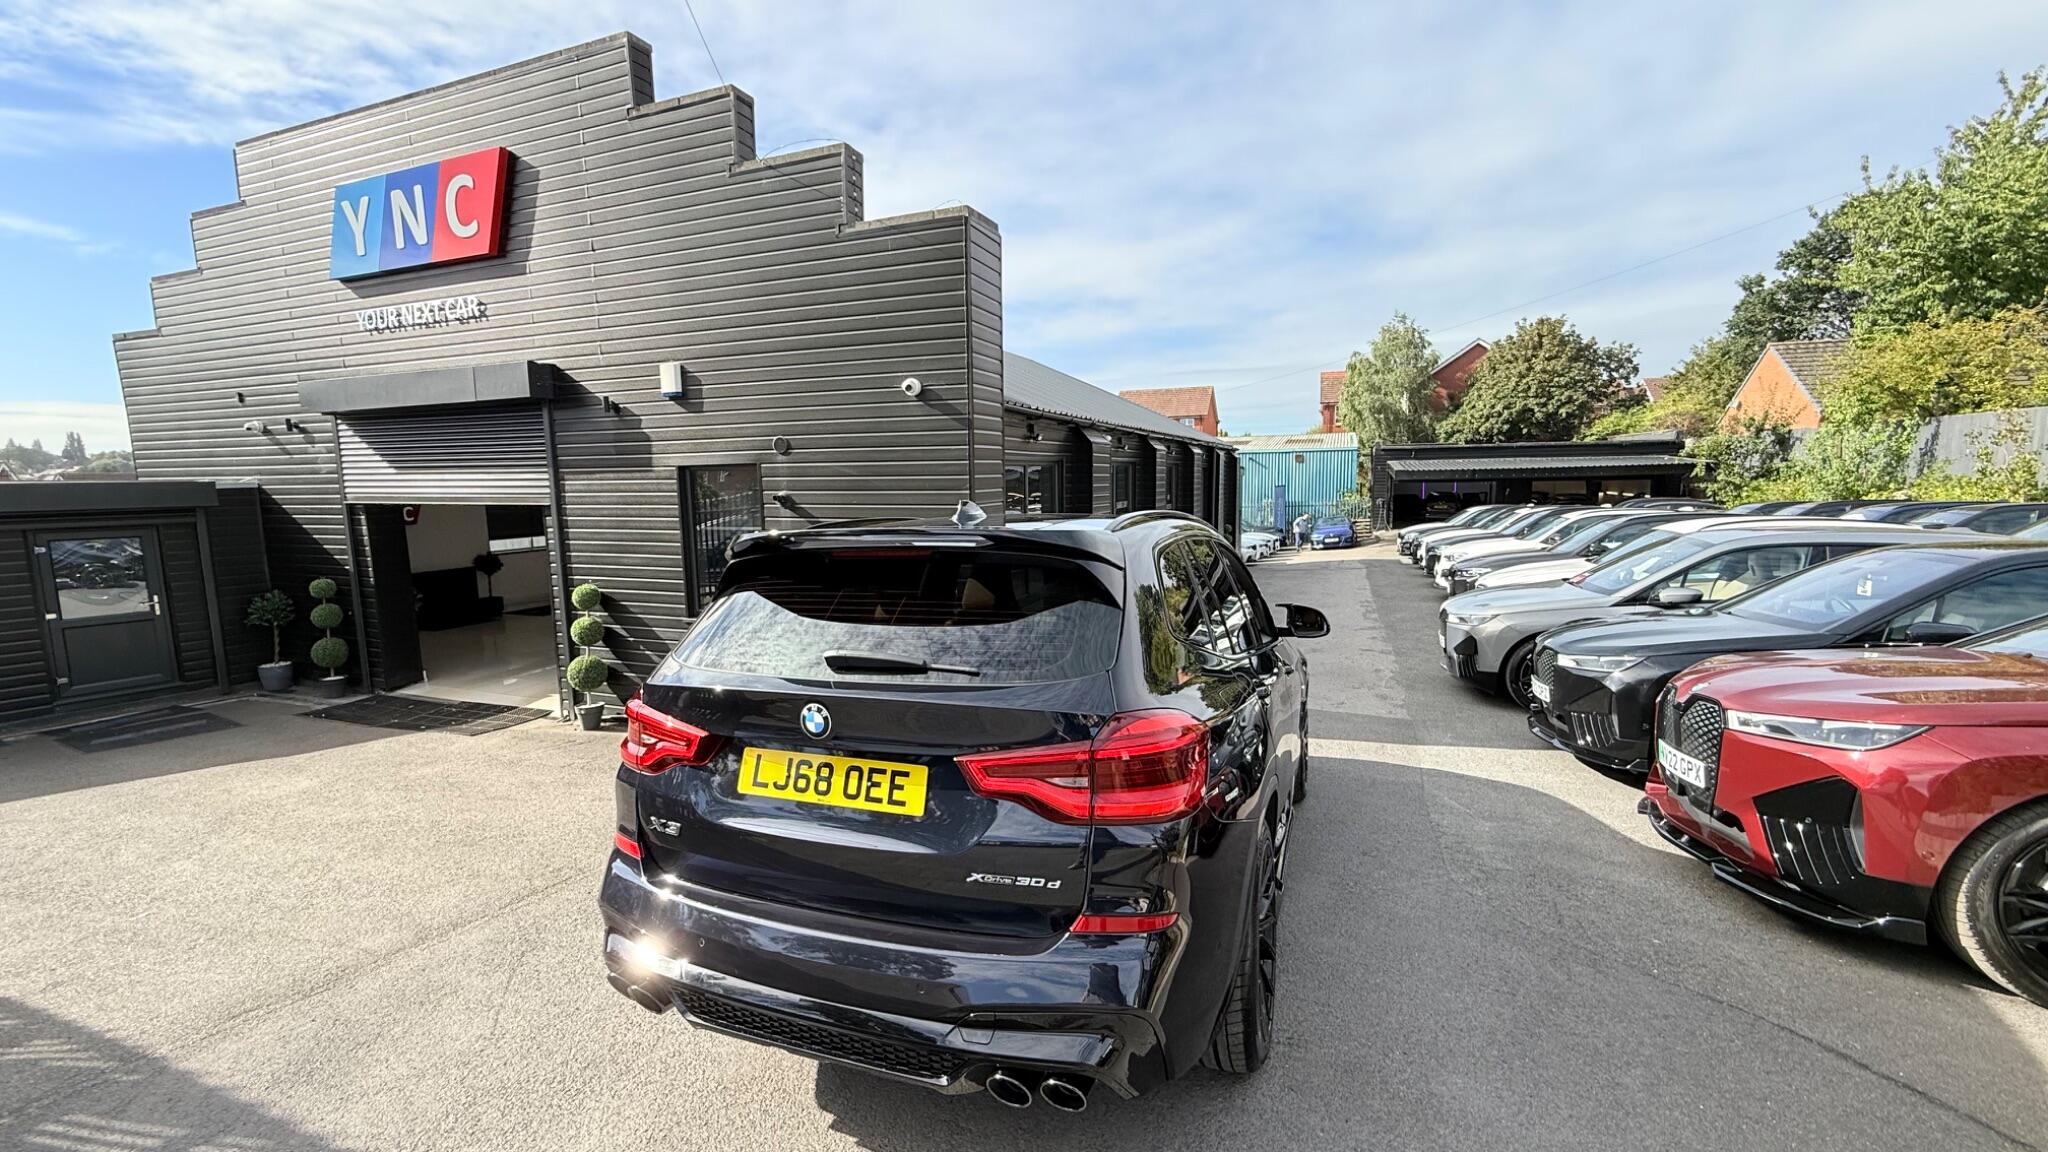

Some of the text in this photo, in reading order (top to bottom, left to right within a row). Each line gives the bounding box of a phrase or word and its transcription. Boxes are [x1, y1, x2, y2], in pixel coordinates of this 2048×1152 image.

[341, 173, 480, 257] YNC
[356, 296, 480, 331] YOUR NEXT CAR
[752, 754, 911, 807] LJ68 OEE
[1680, 757, 1702, 784] GPX
[649, 816, 681, 836] X3
